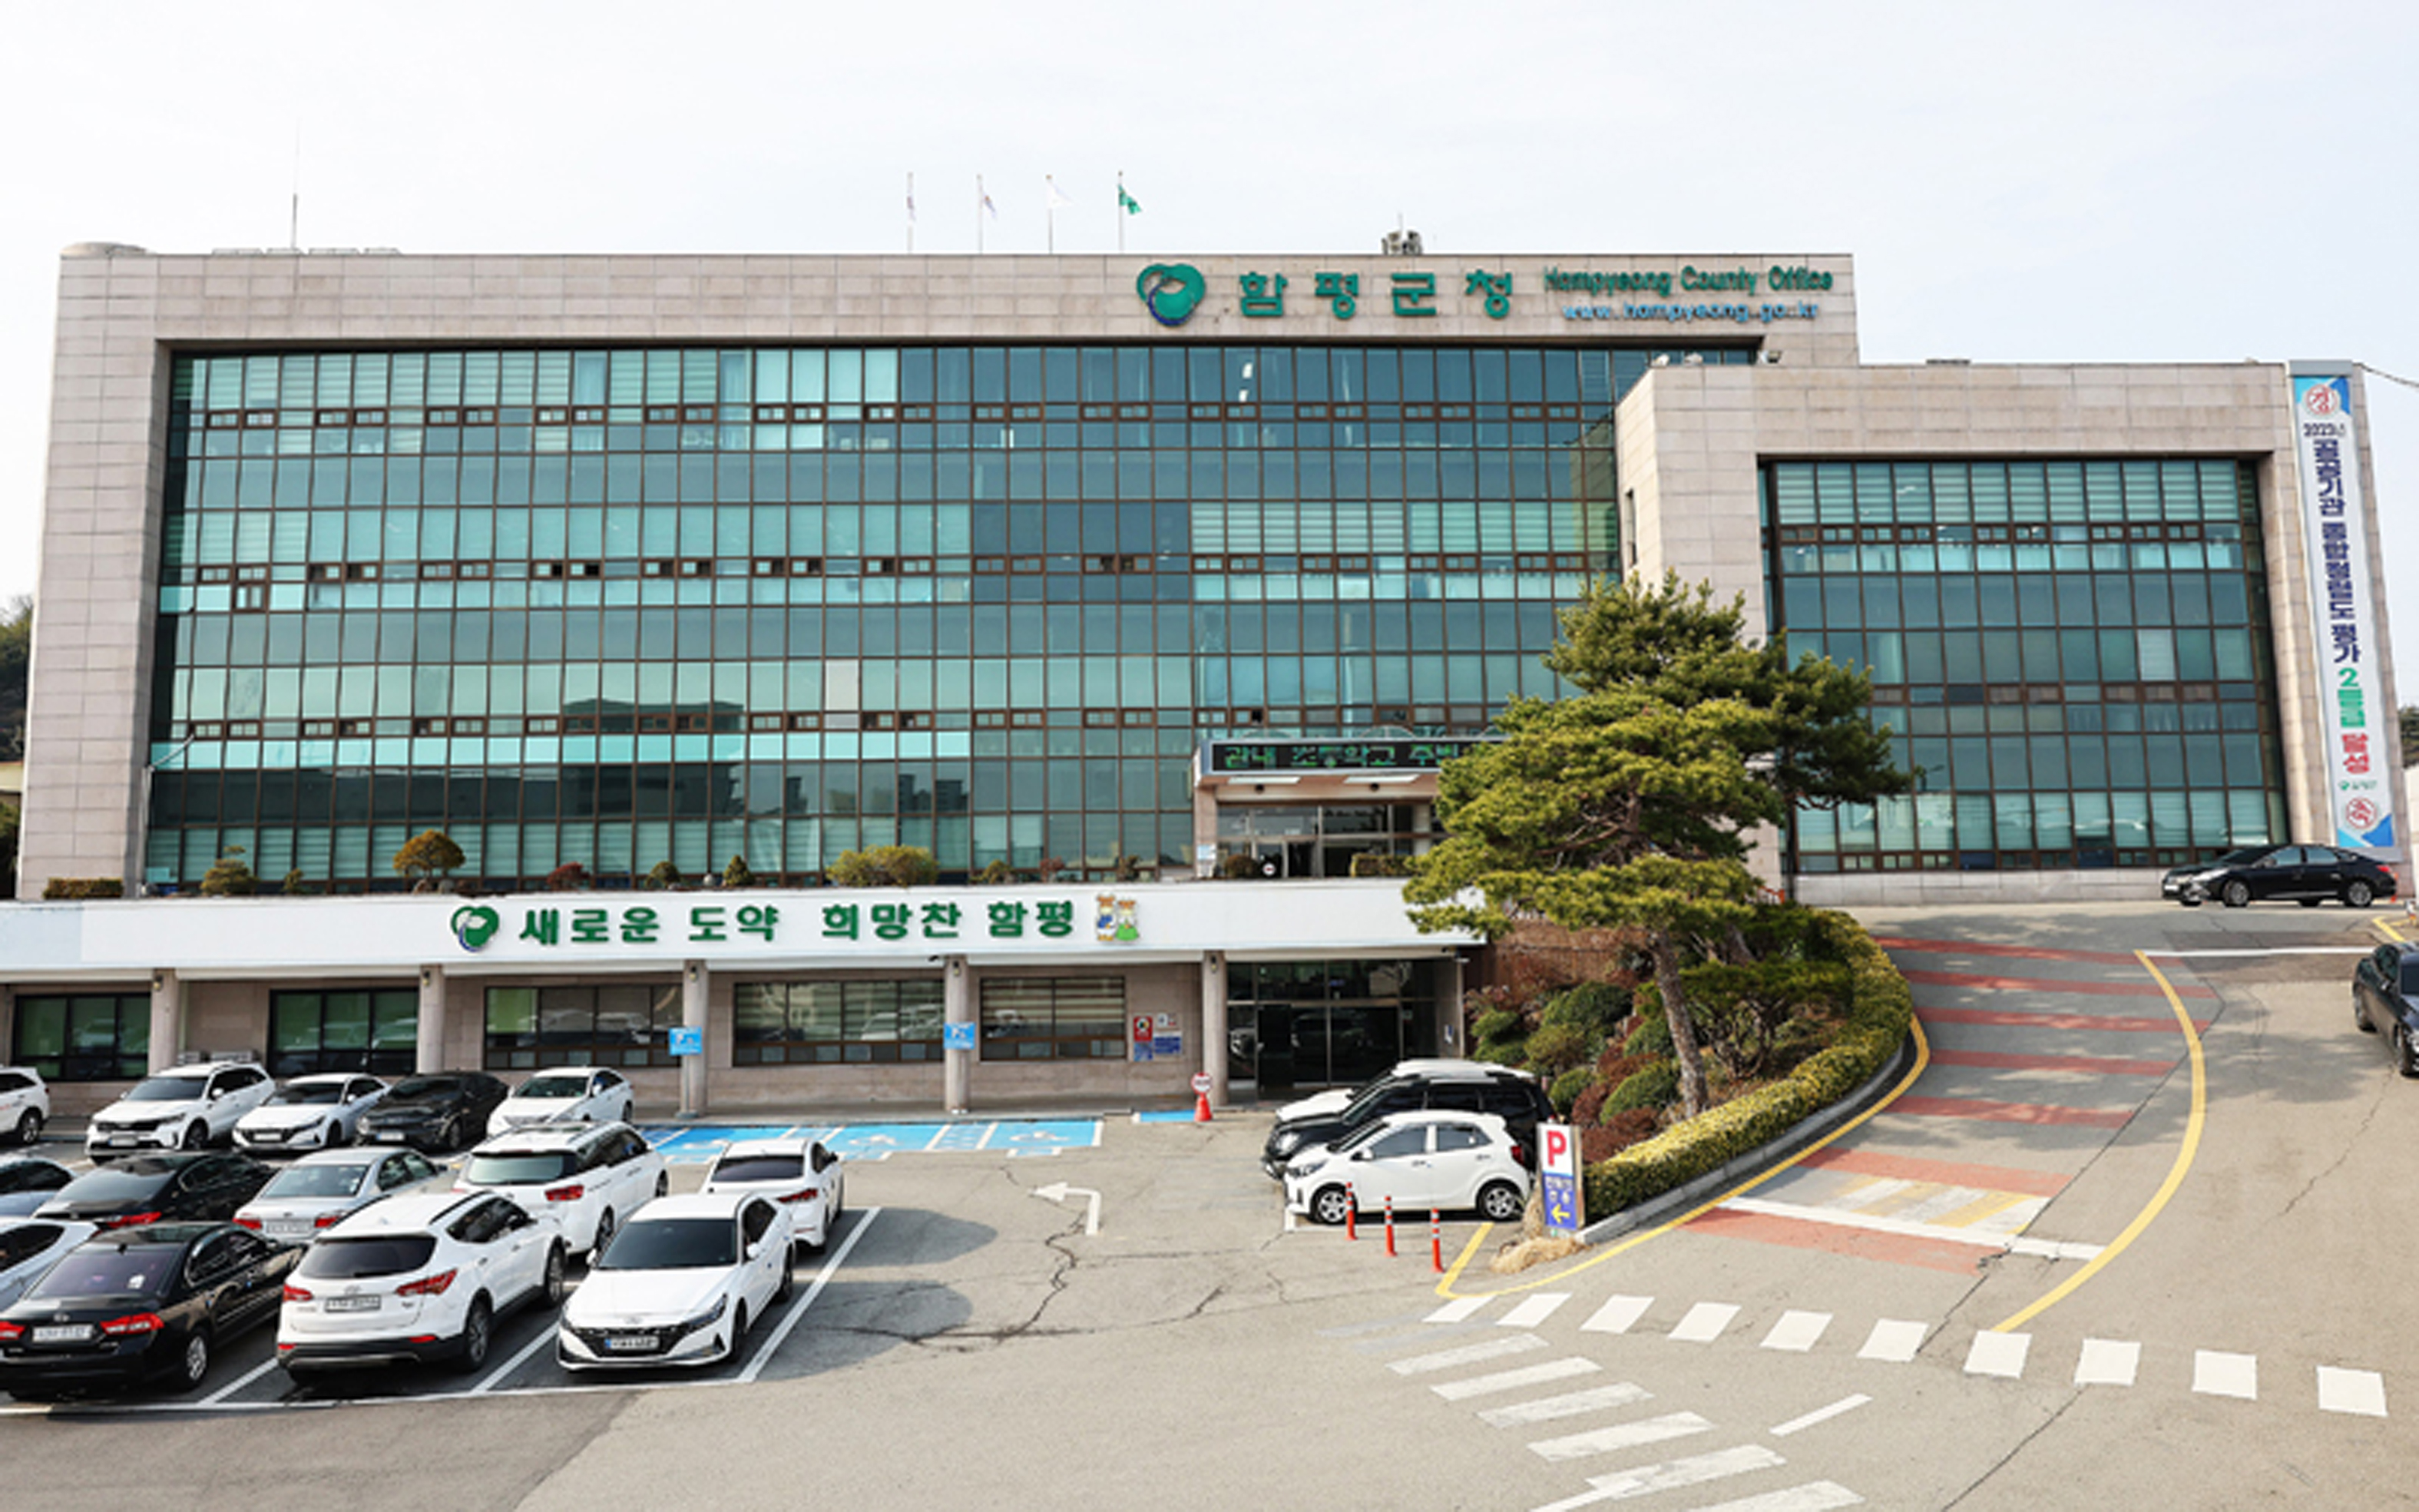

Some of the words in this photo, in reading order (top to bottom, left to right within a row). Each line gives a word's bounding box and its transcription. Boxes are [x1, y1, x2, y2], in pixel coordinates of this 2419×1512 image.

[1239, 269, 1513, 319] 함평군청
[1543, 266, 1673, 297] Hampyeong
[1679, 265, 1759, 296] County
[1768, 264, 1834, 291] Office
[1562, 300, 1819, 323] www.hampyeong.go.kr
[2313, 438, 2345, 517] 공공기관
[2331, 624, 2361, 663] 평가
[519, 907, 660, 945] 새로운
[689, 905, 779, 941] 도약
[822, 903, 962, 941] 희망찬
[988, 901, 1073, 938] 함평
[1547, 1130, 1567, 1166] P
